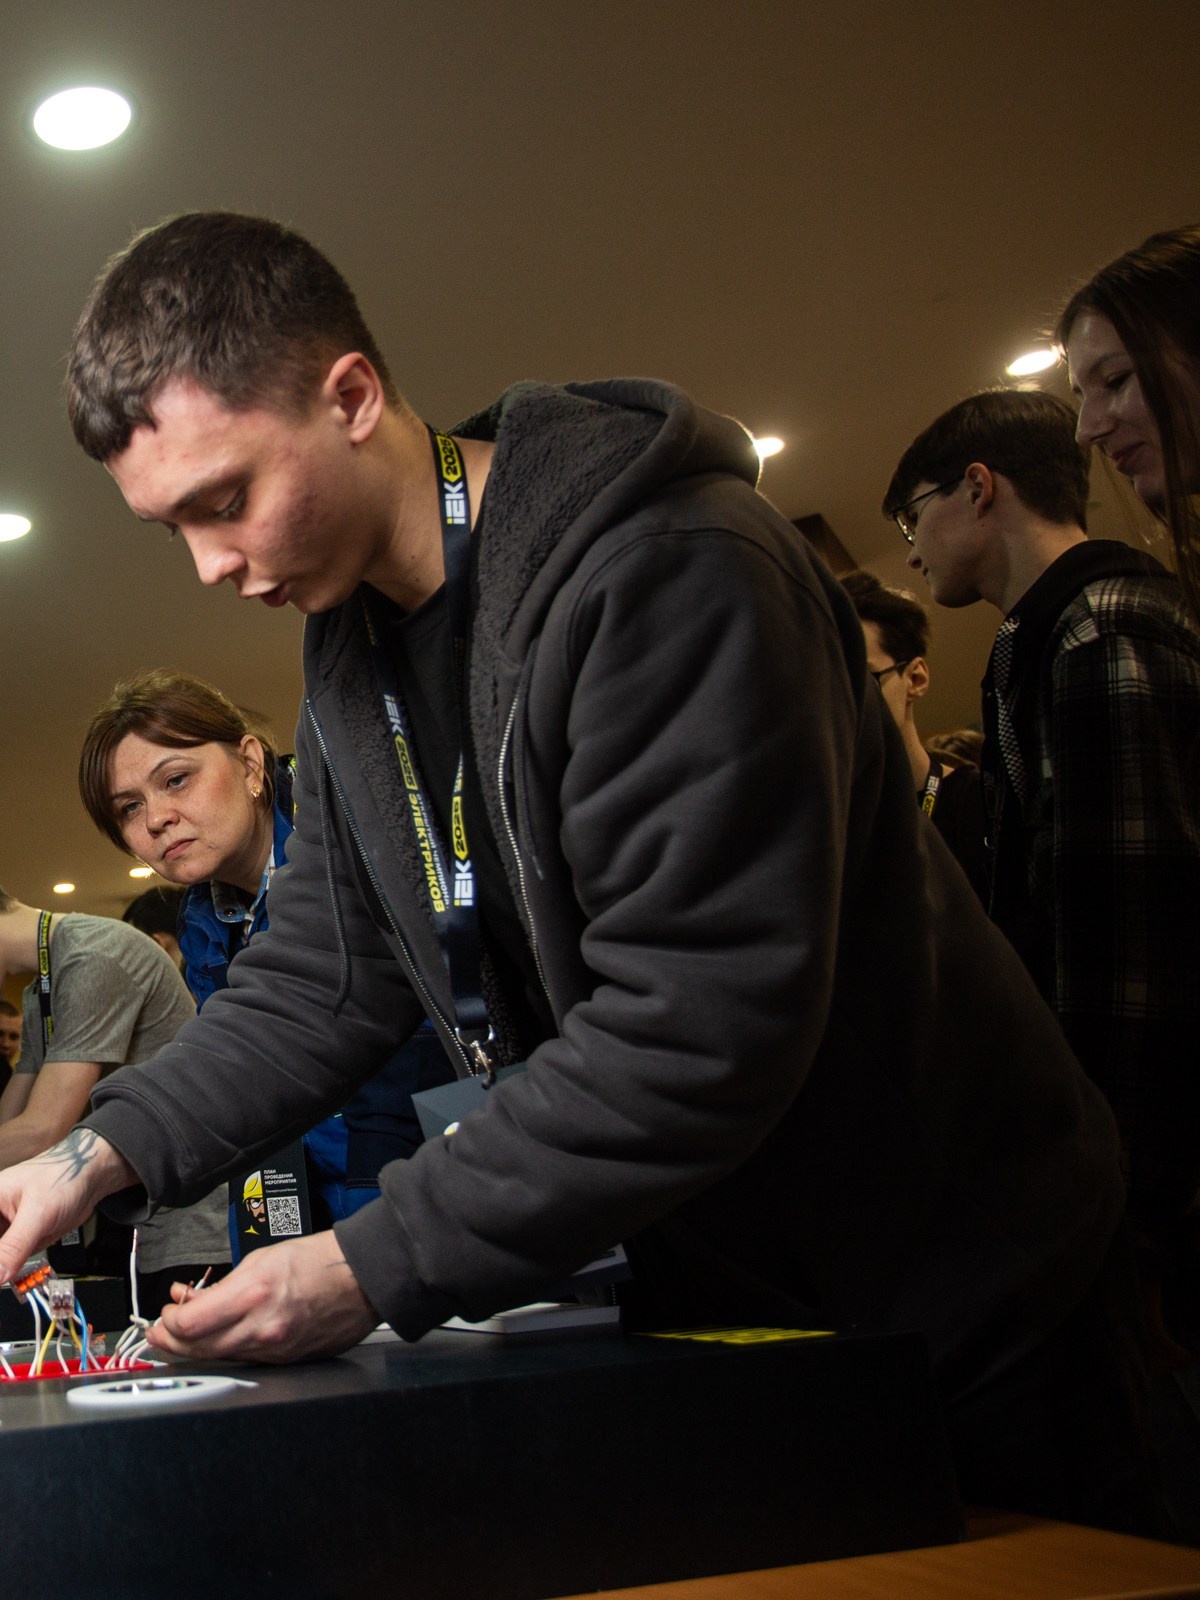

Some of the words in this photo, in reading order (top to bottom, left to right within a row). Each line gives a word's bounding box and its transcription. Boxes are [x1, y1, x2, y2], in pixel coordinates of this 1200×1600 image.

[440, 437, 459, 476] 2025
[396, 740, 415, 786] 2025
[408, 792, 446, 913] ЭЛЕКТРИКОВ
[416, 793, 437, 849] ОТКРЫТЫЙ
[433, 849, 450, 909] ЧЕМПИОНА
[453, 801, 465, 853] 2025
